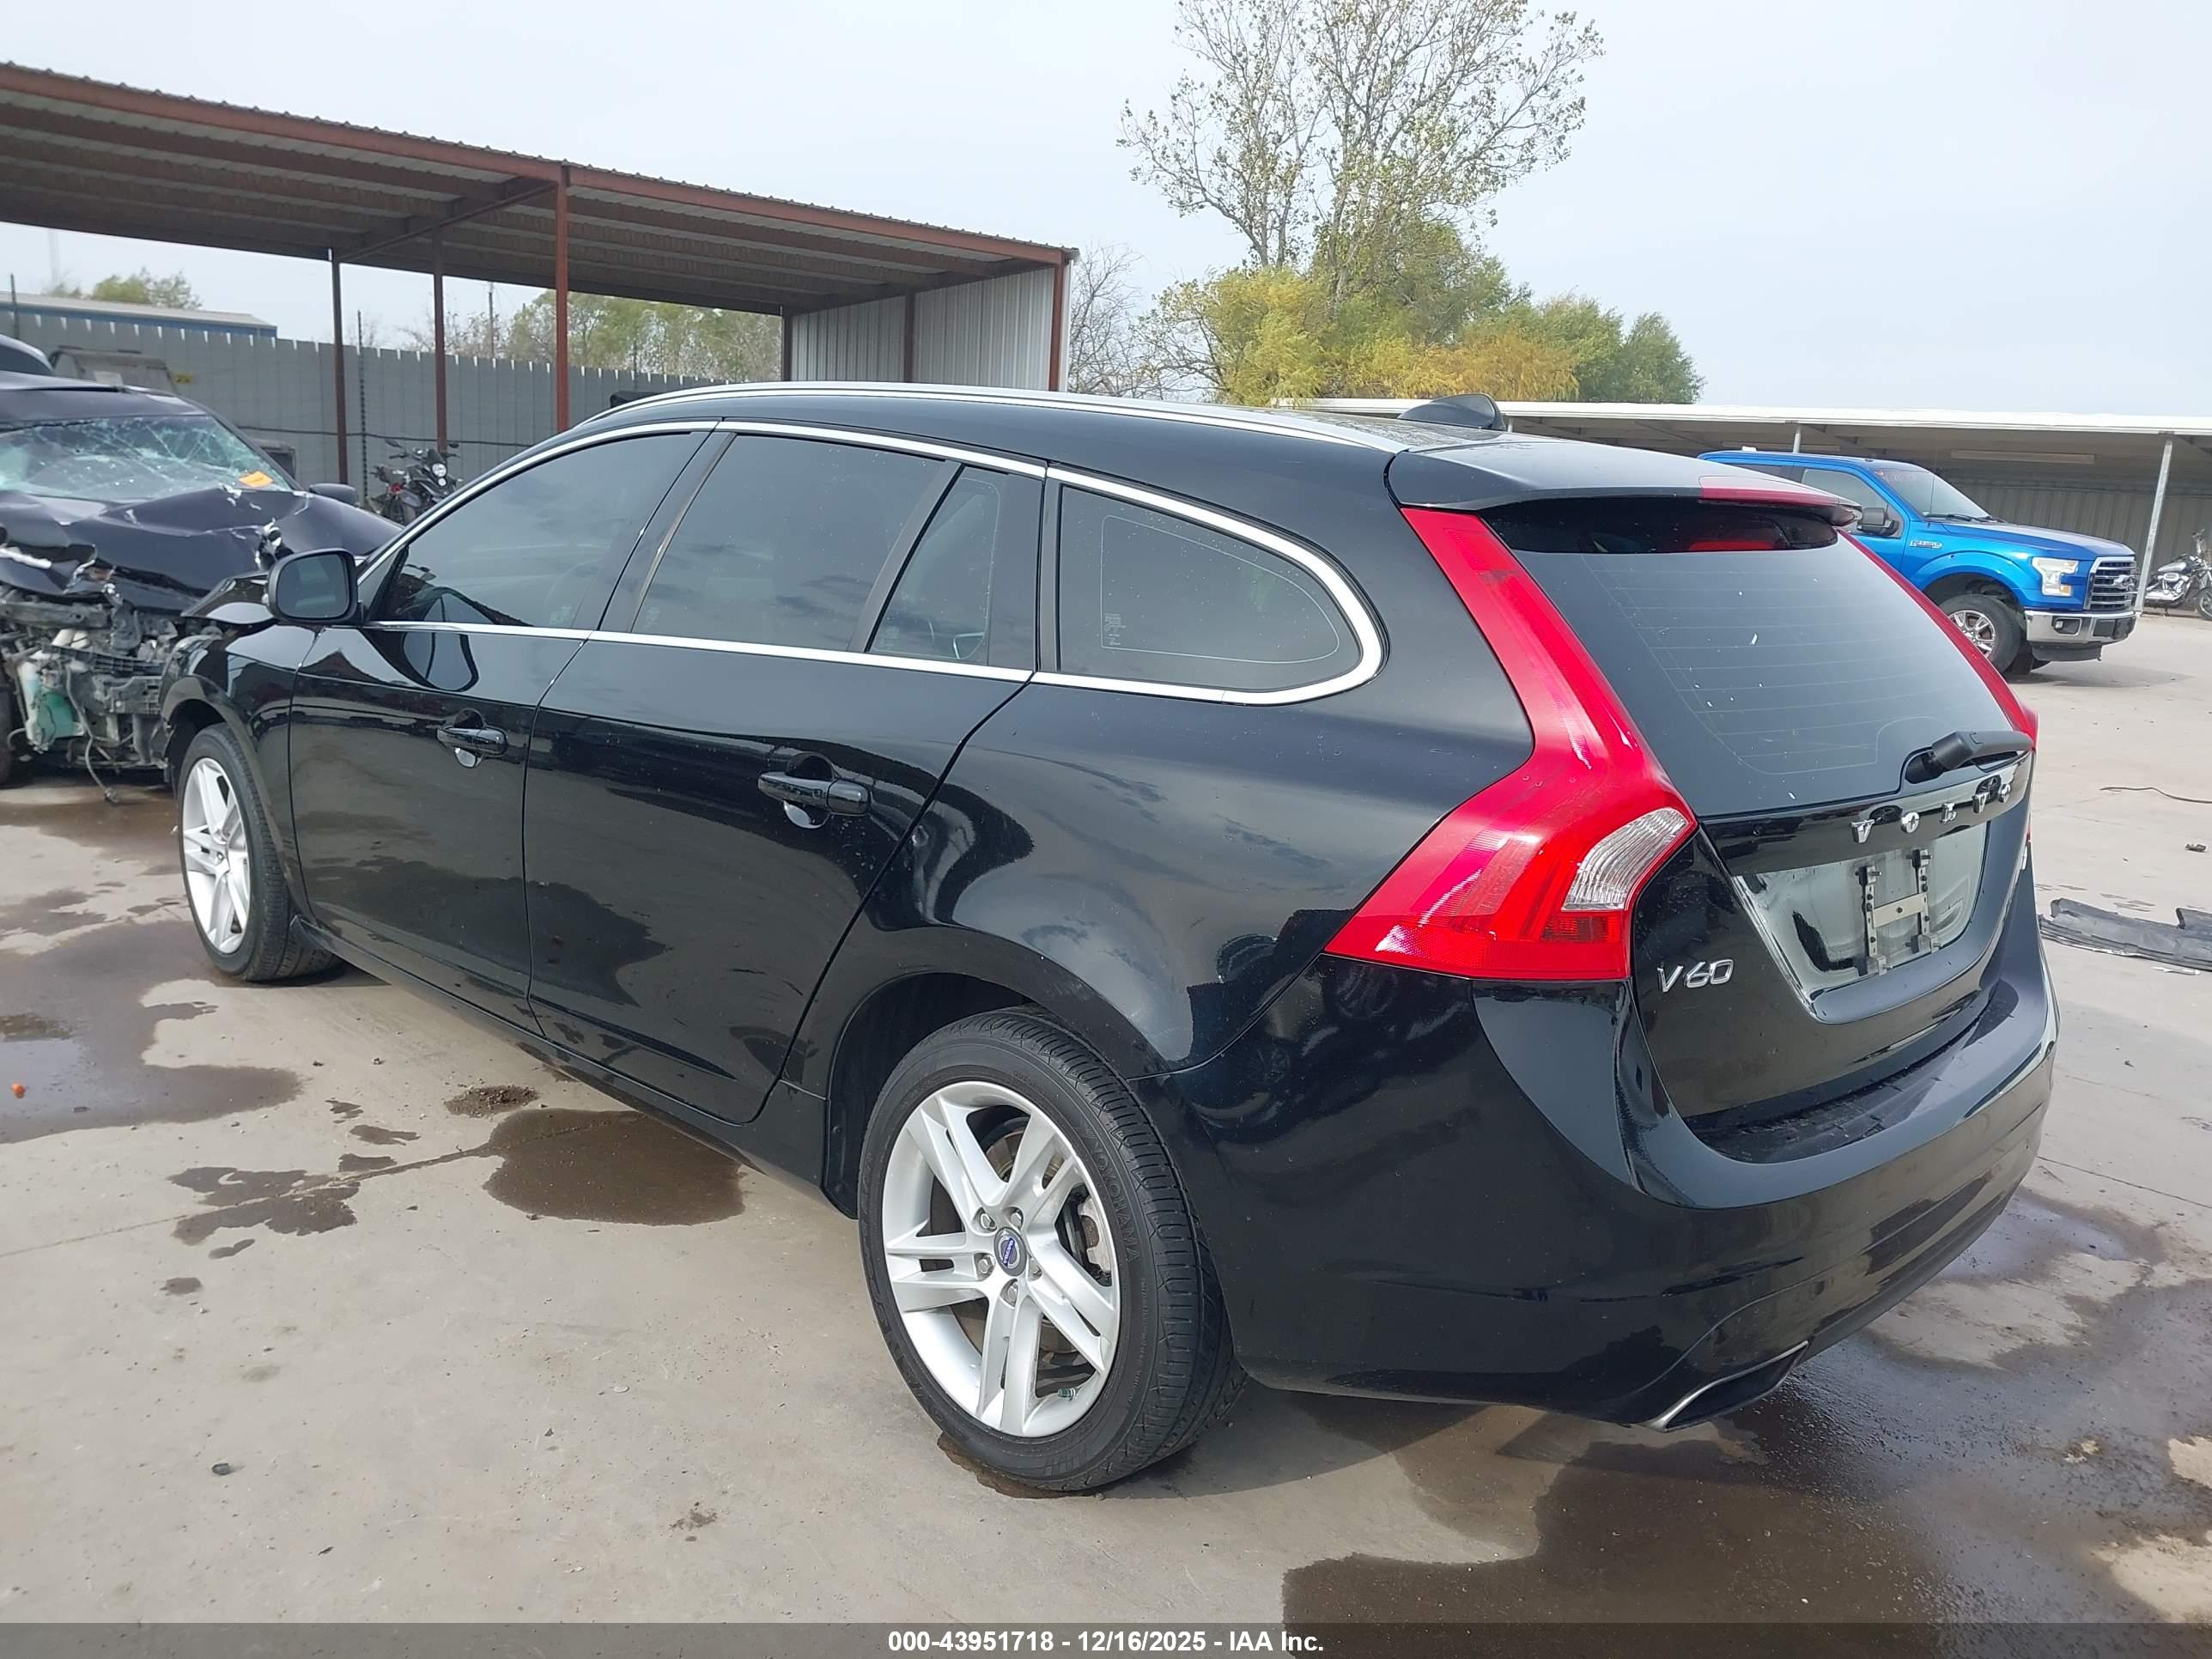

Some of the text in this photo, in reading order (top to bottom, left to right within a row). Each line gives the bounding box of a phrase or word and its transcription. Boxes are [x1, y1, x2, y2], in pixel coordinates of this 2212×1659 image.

[1850, 783, 2011, 844] VOLVO
[1656, 958, 1734, 993] V60
[1091, 1140, 1140, 1263] YOKOHAMA
